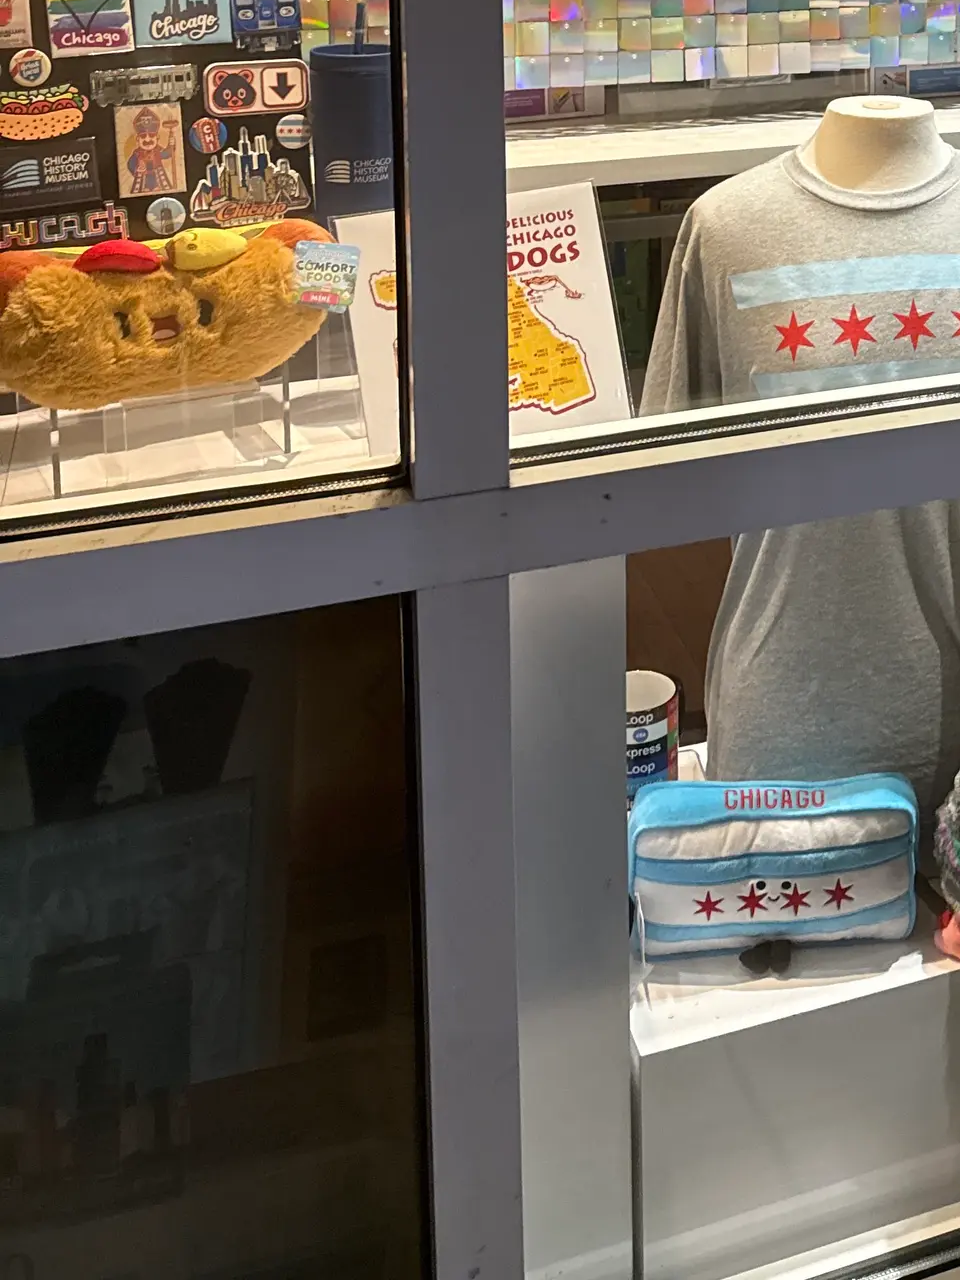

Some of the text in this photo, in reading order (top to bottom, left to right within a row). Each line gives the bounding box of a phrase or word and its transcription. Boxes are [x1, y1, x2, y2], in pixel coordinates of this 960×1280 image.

[151, 14, 219, 40] Chicago
[61, 27, 121, 47] Chicago
[43, 152, 90, 167] CHICAGO
[353, 157, 392, 168] CHICAGO
[43, 162, 87, 176] HISTORY
[353, 165, 389, 176] HISTORY
[44, 170, 89, 184] MUSEUM
[353, 173, 390, 184] MUSEUM
[507, 240, 580, 272] DOGS
[296, 260, 356, 275] COMFORT
[306, 272, 342, 284] FOOD
[724, 787, 826, 811] CHICAGO
